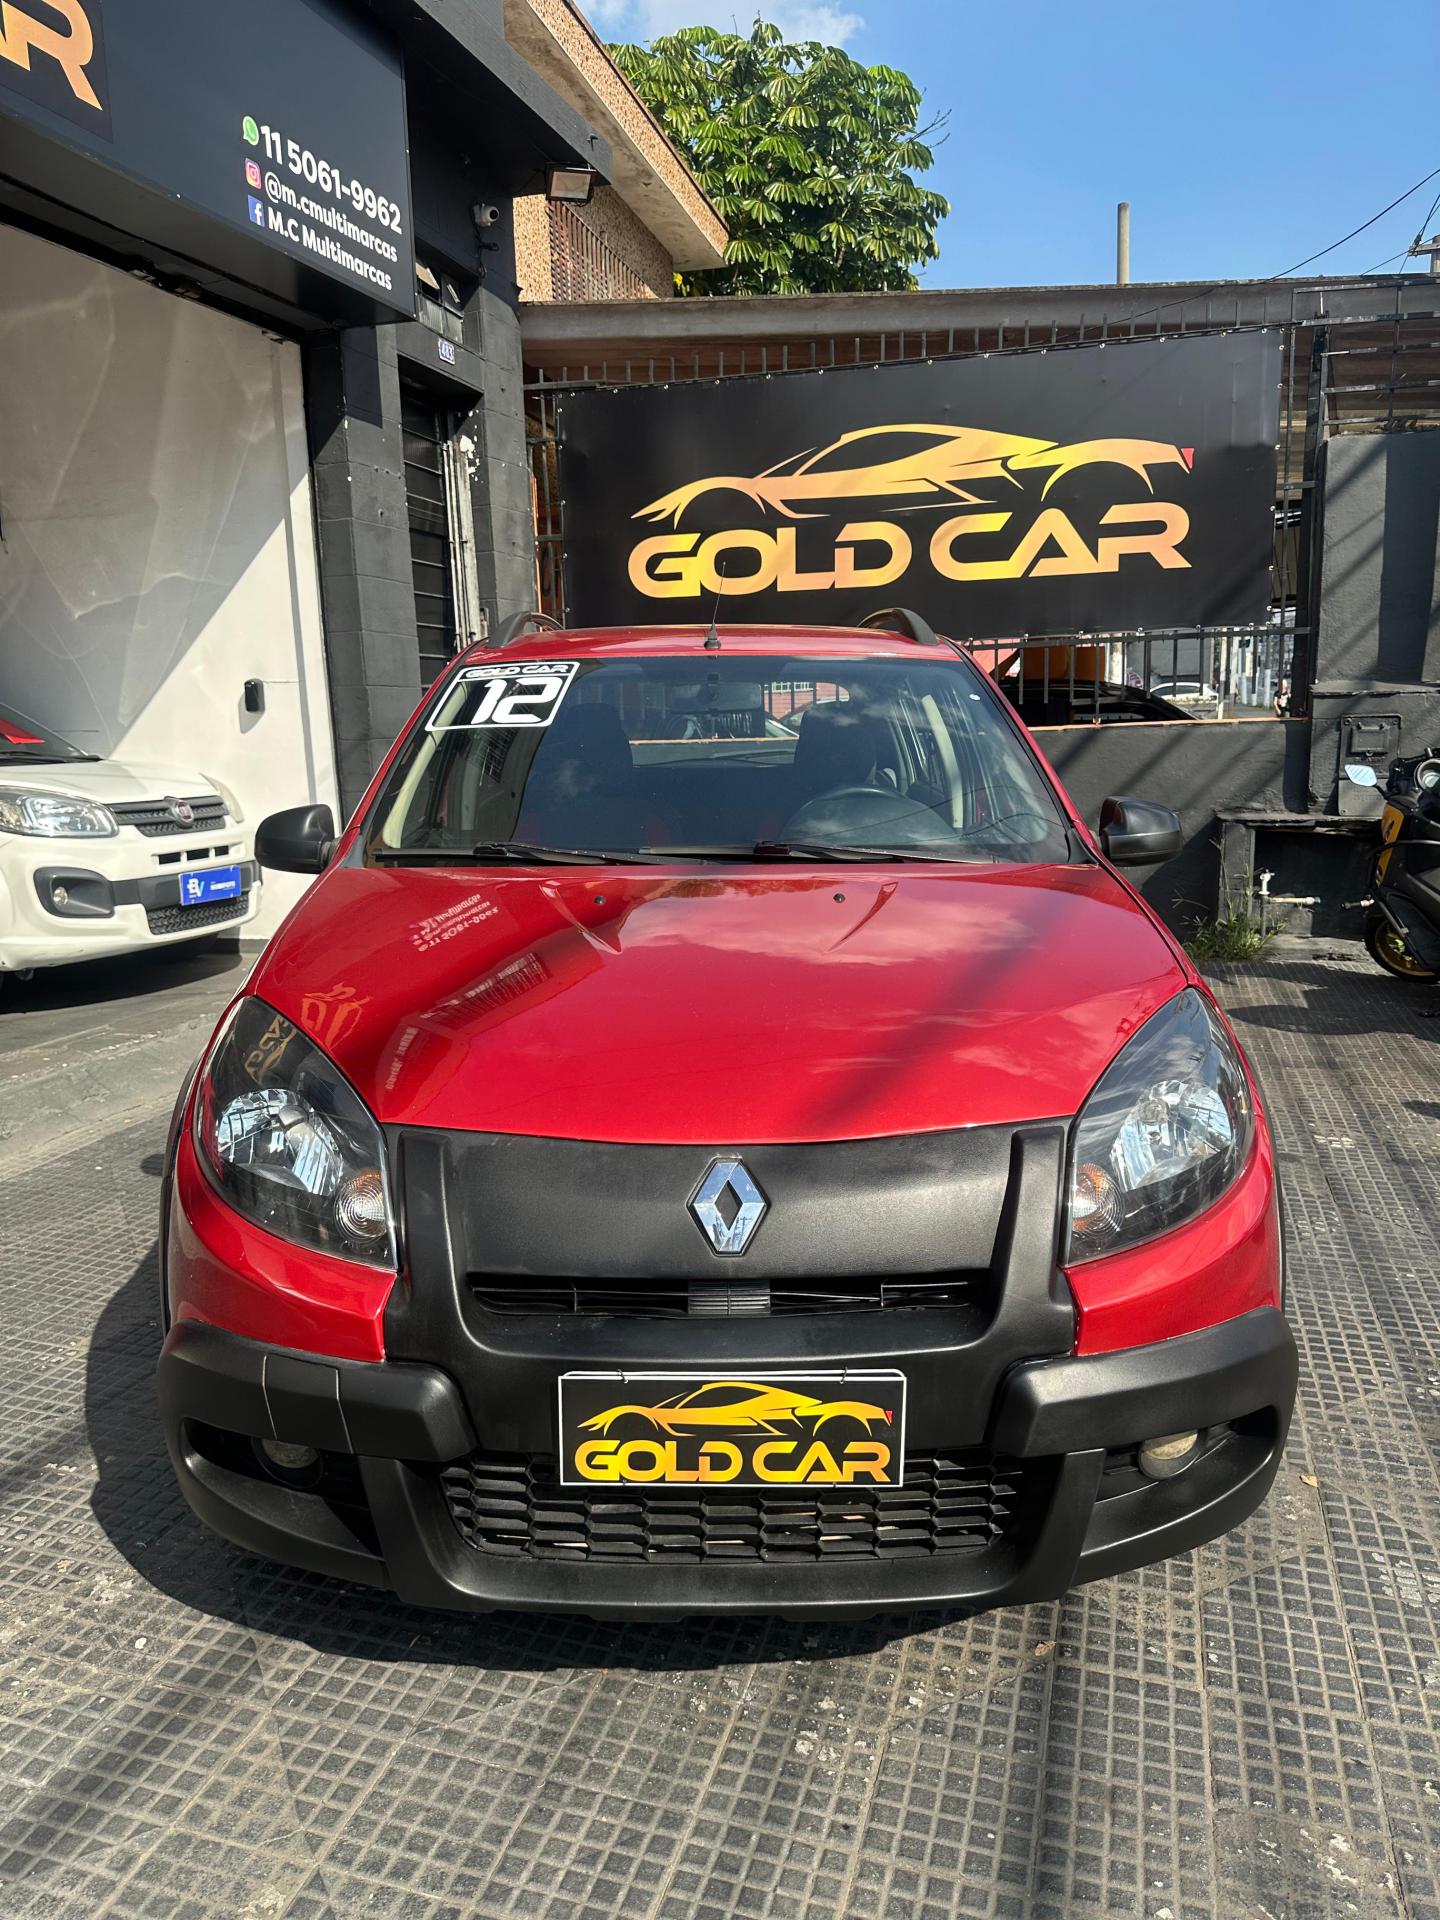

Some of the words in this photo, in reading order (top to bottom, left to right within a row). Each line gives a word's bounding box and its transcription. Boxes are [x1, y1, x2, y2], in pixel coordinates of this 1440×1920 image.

[260, 125, 283, 165] 11
[287, 139, 402, 235] 5061-9962
[264, 171, 398, 262] @m.cmultimarcas
[268, 206, 300, 242] M.C
[302, 224, 392, 291] Multimarcas
[628, 521, 912, 598] GOLD
[929, 502, 1192, 581] CAR
[465, 666, 520, 678] GOLD
[522, 664, 569, 674] CAR
[470, 676, 563, 724] 12
[574, 1439, 743, 1482] GOLD
[752, 1440, 891, 1482] CAR
